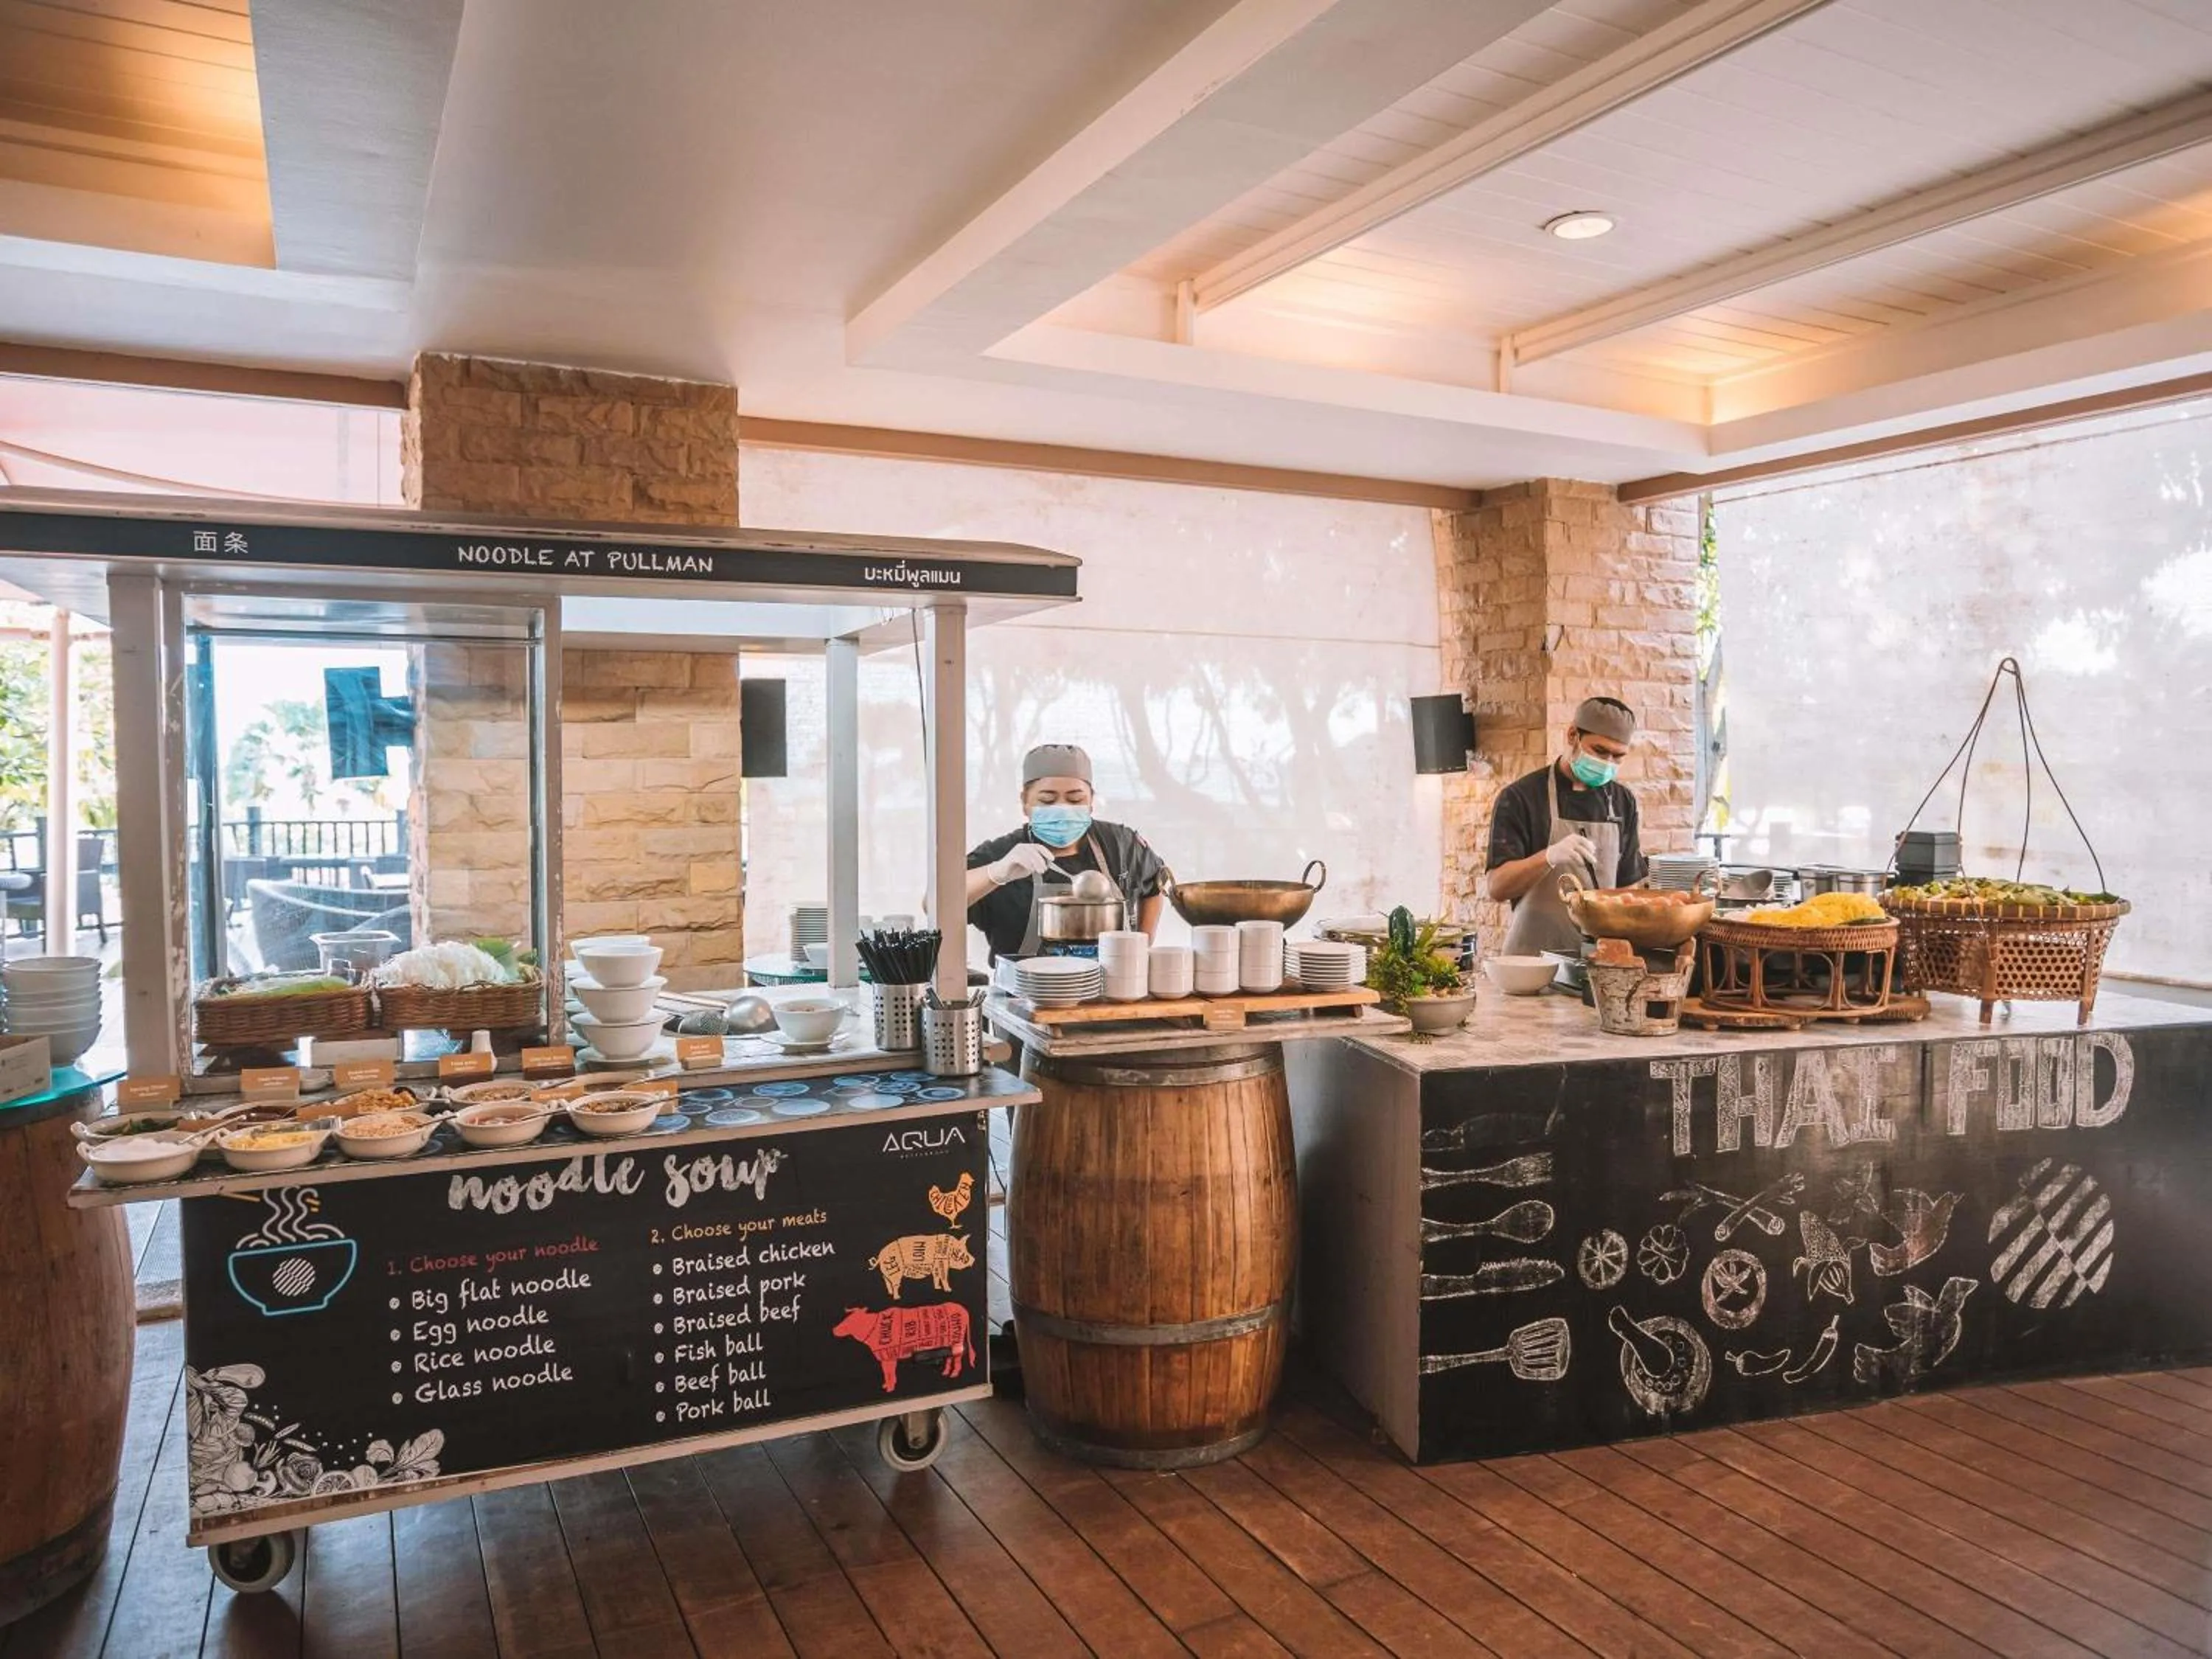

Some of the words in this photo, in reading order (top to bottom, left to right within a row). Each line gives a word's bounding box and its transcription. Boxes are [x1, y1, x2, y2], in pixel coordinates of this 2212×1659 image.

[193, 531, 248, 554] 面条
[458, 546, 553, 566] NOODLE
[564, 550, 595, 568] AT
[607, 551, 713, 573] PULLMAN
[864, 560, 961, 588] บะหมี่พูลแมน
[1649, 1048, 1896, 1157] THAI
[1947, 1033, 2135, 1135] FOOD
[882, 1126, 966, 1152] AQUA
[448, 1155, 644, 1214] noodle
[665, 1147, 788, 1207] soup
[651, 1229, 665, 1244] 2.
[672, 1223, 732, 1241] Choose
[738, 1218, 775, 1242] your
[782, 1208, 827, 1228] meats
[410, 1255, 477, 1273] Choose
[485, 1248, 526, 1273] your
[535, 1236, 599, 1257] noodle
[672, 1245, 751, 1276] Braised
[759, 1240, 835, 1263] chicken
[412, 1289, 448, 1314] Big
[459, 1278, 501, 1310] flat
[511, 1267, 591, 1296] noodle
[673, 1274, 751, 1305] Braised
[759, 1271, 806, 1301] pork
[413, 1321, 456, 1346] Egg
[467, 1304, 549, 1333] noodle
[673, 1303, 751, 1335] Braised
[759, 1294, 801, 1324] beef
[414, 1351, 465, 1373] Rice
[474, 1334, 555, 1363] noodle
[675, 1339, 717, 1363] Fish
[725, 1332, 763, 1357] ball
[414, 1380, 482, 1403] Glass
[493, 1362, 573, 1391] noodle
[675, 1363, 720, 1393] Beef
[728, 1360, 766, 1385] ball
[675, 1399, 725, 1422] Pork
[734, 1388, 771, 1413] ball
